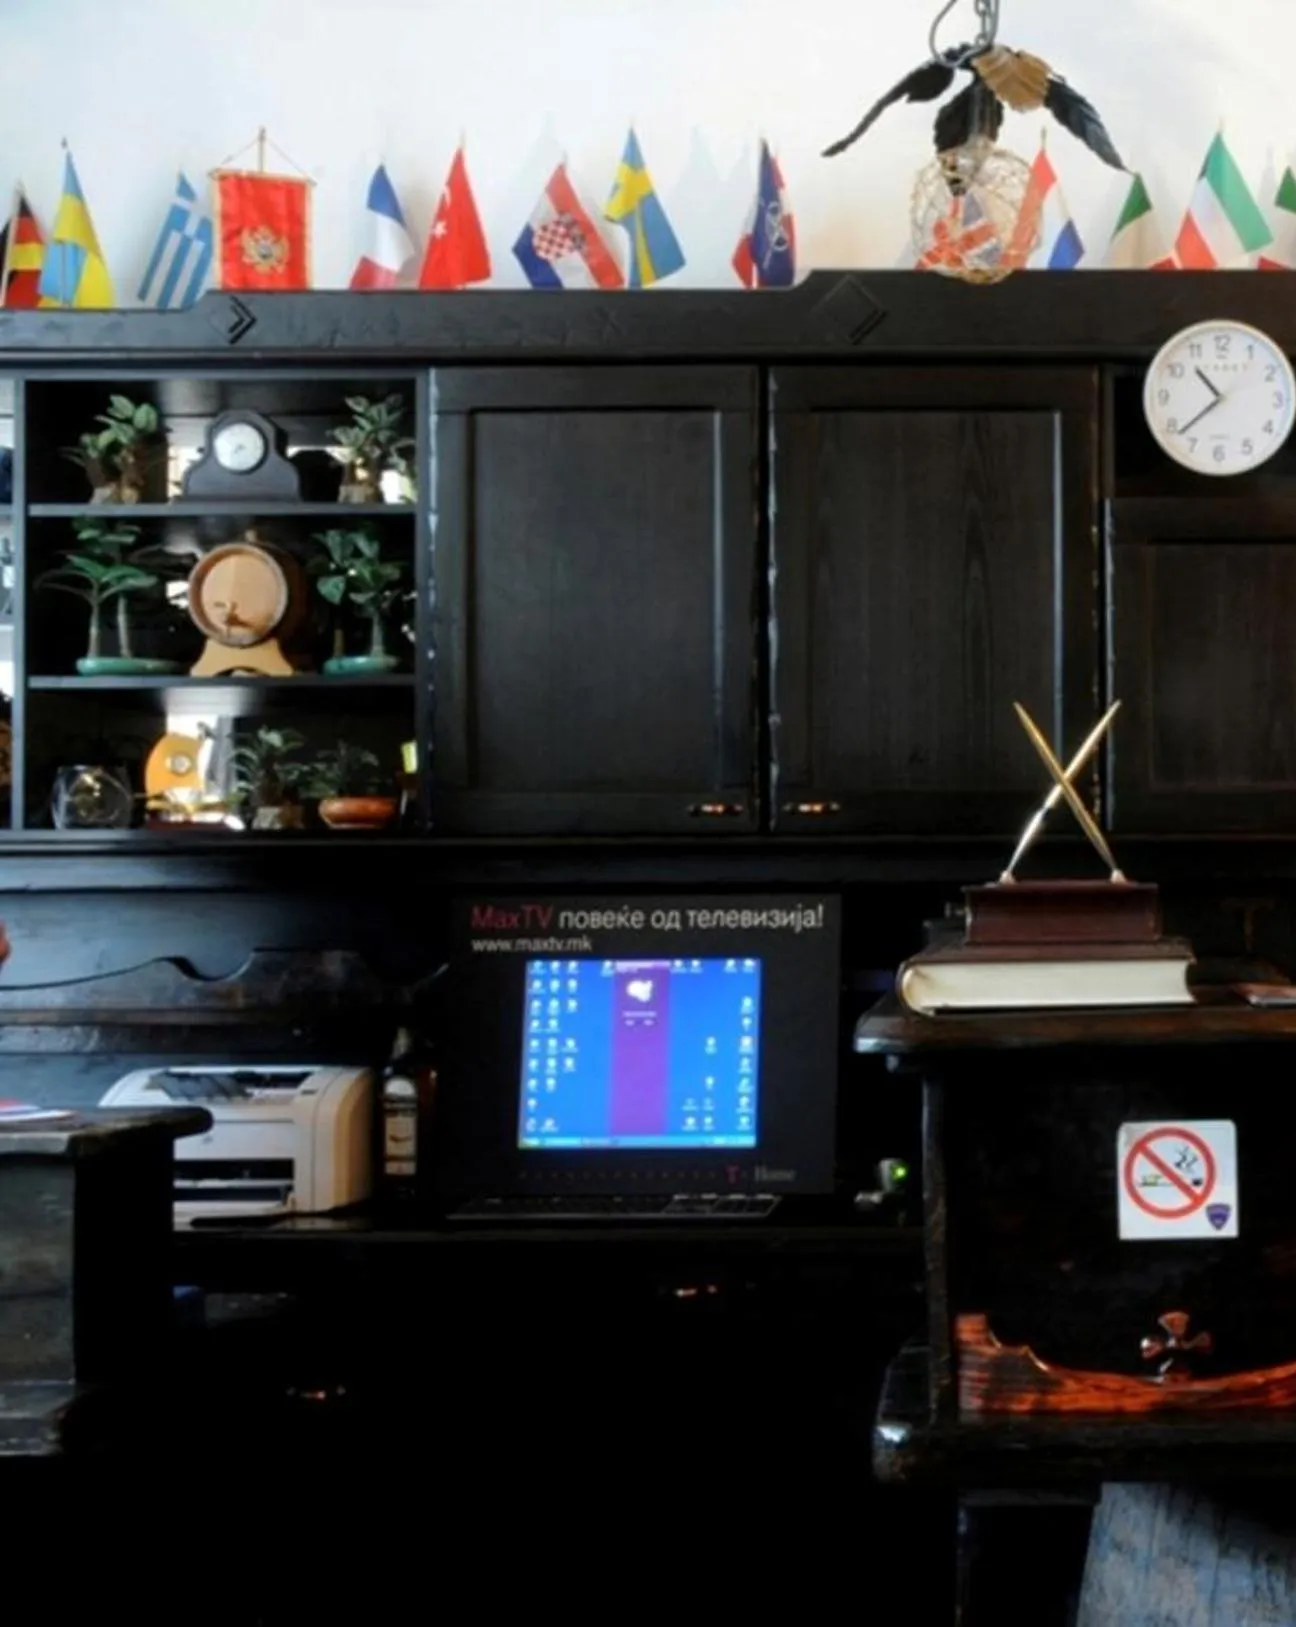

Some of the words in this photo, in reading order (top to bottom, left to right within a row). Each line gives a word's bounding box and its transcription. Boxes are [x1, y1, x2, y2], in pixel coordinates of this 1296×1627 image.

[1189, 344, 1202, 359] 11
[1214, 335, 1230, 352] 12
[1247, 344, 1253, 360] 1
[1167, 363, 1185, 378] 10
[1264, 364, 1276, 382] 2
[1158, 389, 1169, 406] 9
[1273, 391, 1284, 409] 3
[1166, 418, 1178, 434] 8
[1262, 419, 1273, 434] 4
[1187, 437, 1198, 453] 7
[1213, 445, 1225, 462] 6
[1241, 438, 1253, 455] 5
[471, 905, 554, 929] MaxTV
[558, 905, 644, 930] повеќе
[651, 911, 682, 933] од
[687, 903, 824, 934] телевизија!
[472, 935, 593, 953] www.maxtv.mk
